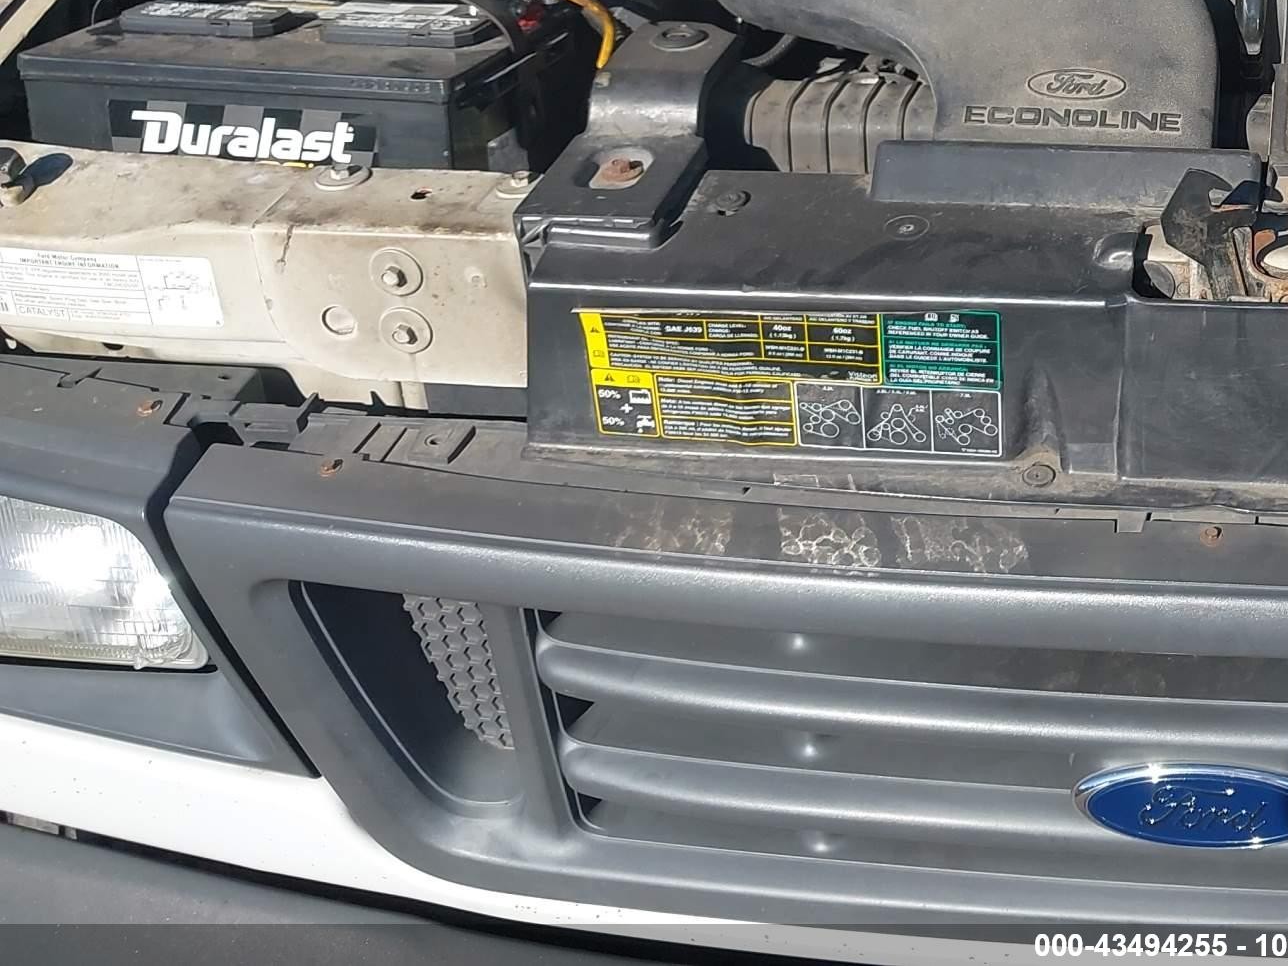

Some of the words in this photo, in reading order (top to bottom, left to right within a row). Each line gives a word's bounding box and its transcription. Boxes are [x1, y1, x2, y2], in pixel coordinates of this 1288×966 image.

[1046, 72, 1108, 96] Ford
[131, 110, 355, 164] Duralast
[963, 104, 1182, 133] ECONOLINE
[1138, 785, 1266, 833] Ford
